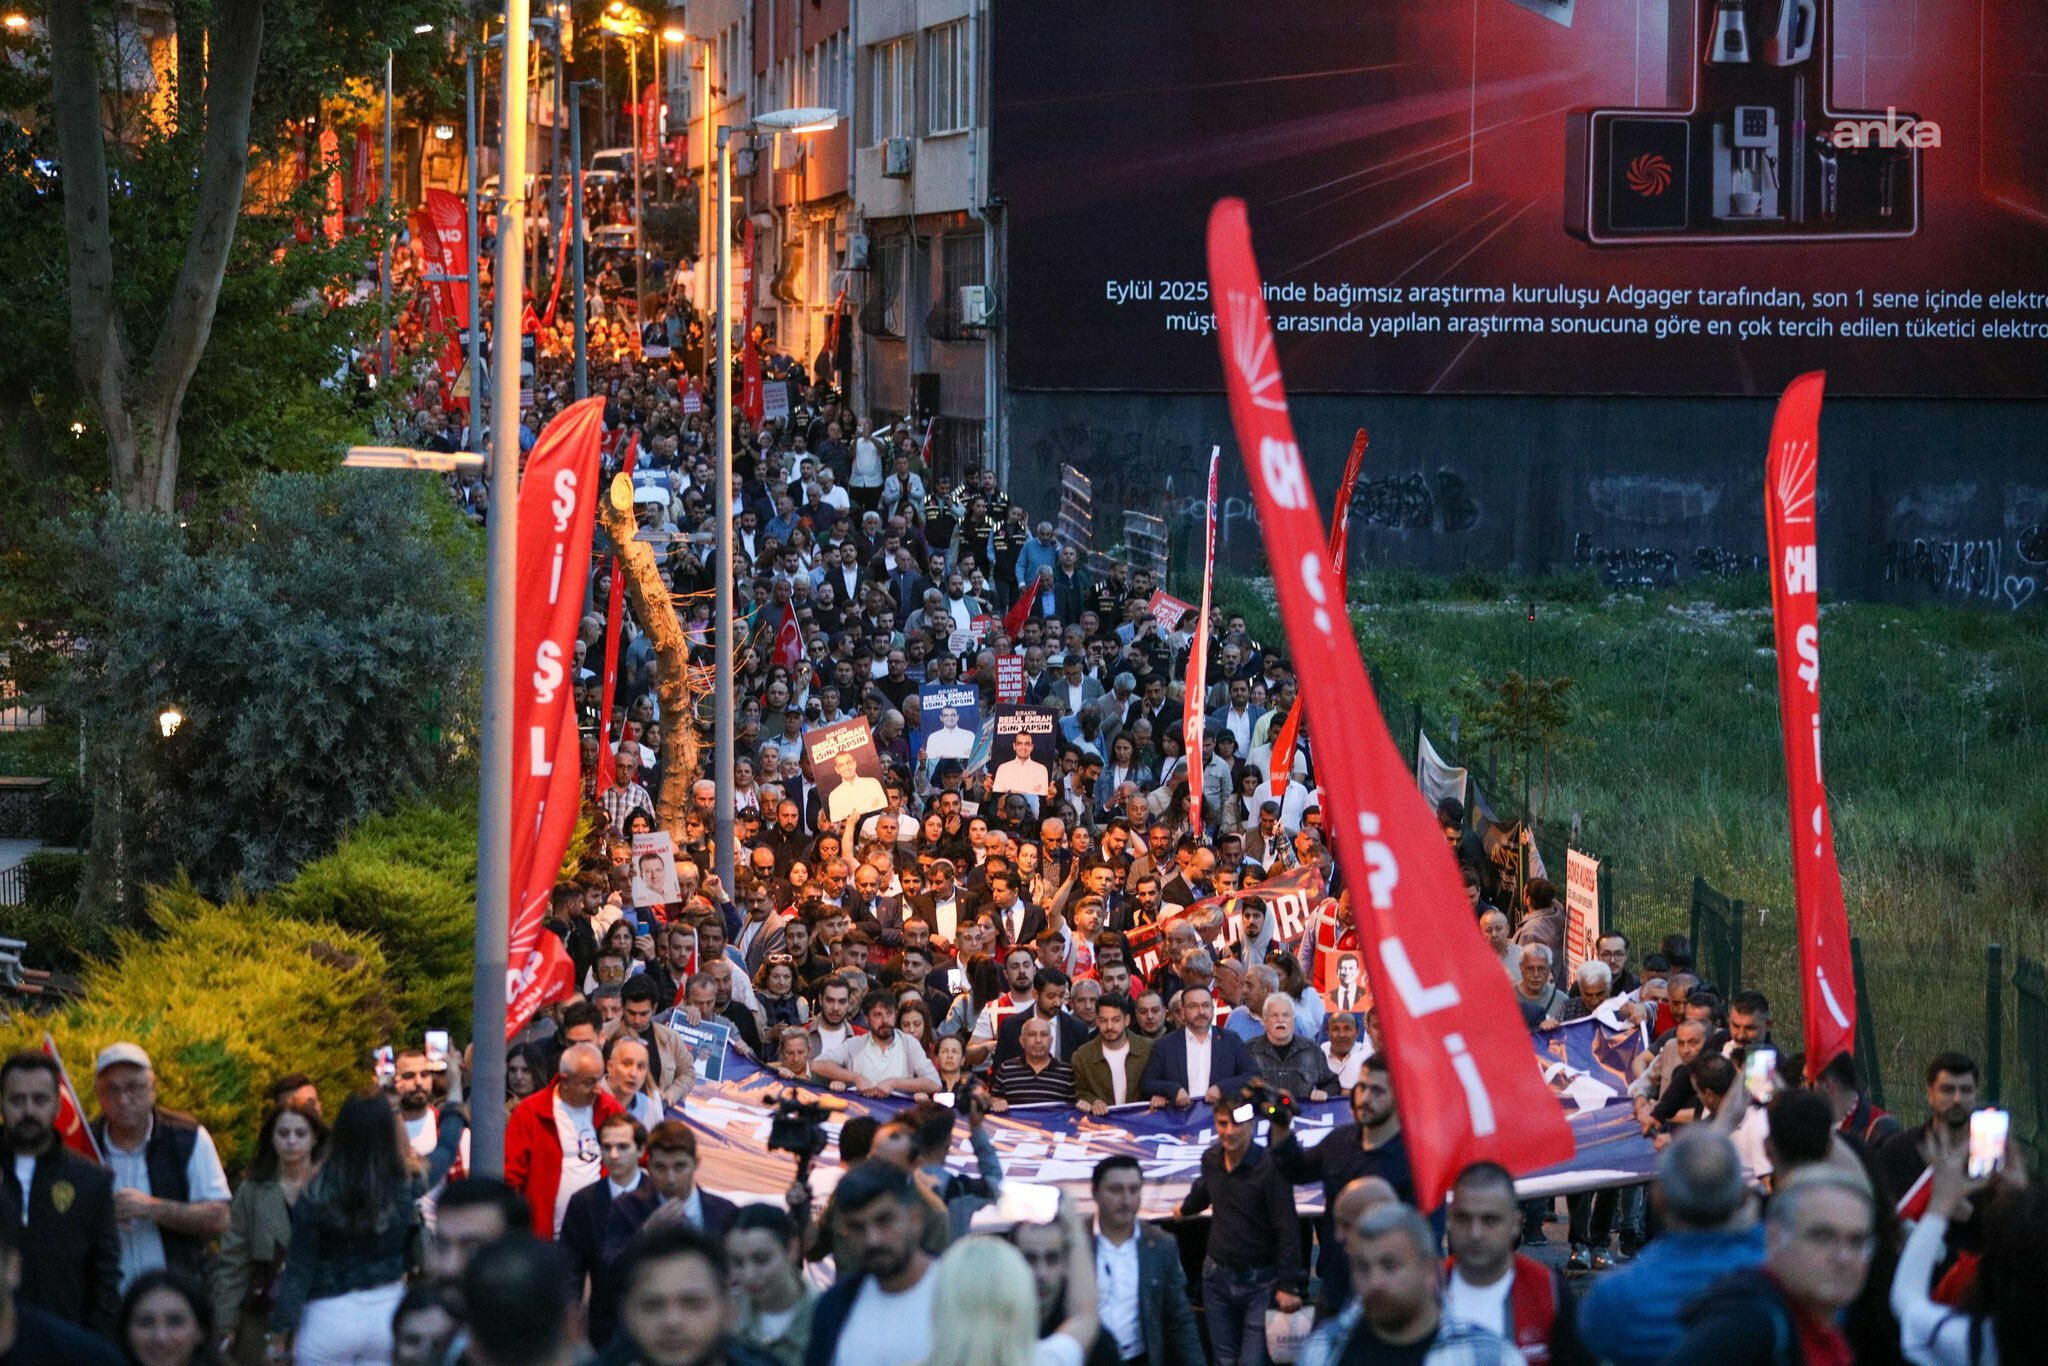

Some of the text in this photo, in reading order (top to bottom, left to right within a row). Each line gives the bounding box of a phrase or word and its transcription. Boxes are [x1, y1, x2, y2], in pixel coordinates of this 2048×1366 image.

[1106, 280, 1152, 304] Eylül
[1160, 282, 1208, 300] 2025
[1313, 283, 1402, 307] bağımsız
[1409, 285, 1505, 307] araştırma
[1512, 283, 1600, 309] kuruluşu
[1606, 285, 1692, 309] Adgager
[1698, 287, 1806, 310] tarafından,
[1812, 291, 1848, 308] son
[1855, 289, 1864, 308] 1
[1873, 292, 1919, 309] sene
[1926, 289, 1982, 313] içinde
[1989, 289, 2048, 309] elektr
[1277, 313, 1363, 332] arasında
[1369, 312, 1441, 337] yapılan
[1447, 314, 1544, 337] araştırma
[1551, 317, 1648, 334] sonucuna
[1655, 315, 1700, 338] göre
[1707, 320, 1731, 335] en
[1738, 316, 1772, 340] çok
[1778, 317, 1833, 337] tercih
[1840, 317, 1899, 337] edilen
[1906, 318, 1975, 338] tüketici
[998, 715, 1053, 724] RESUL EMRAH
[1020, 723, 1050, 732] YAPSIN
